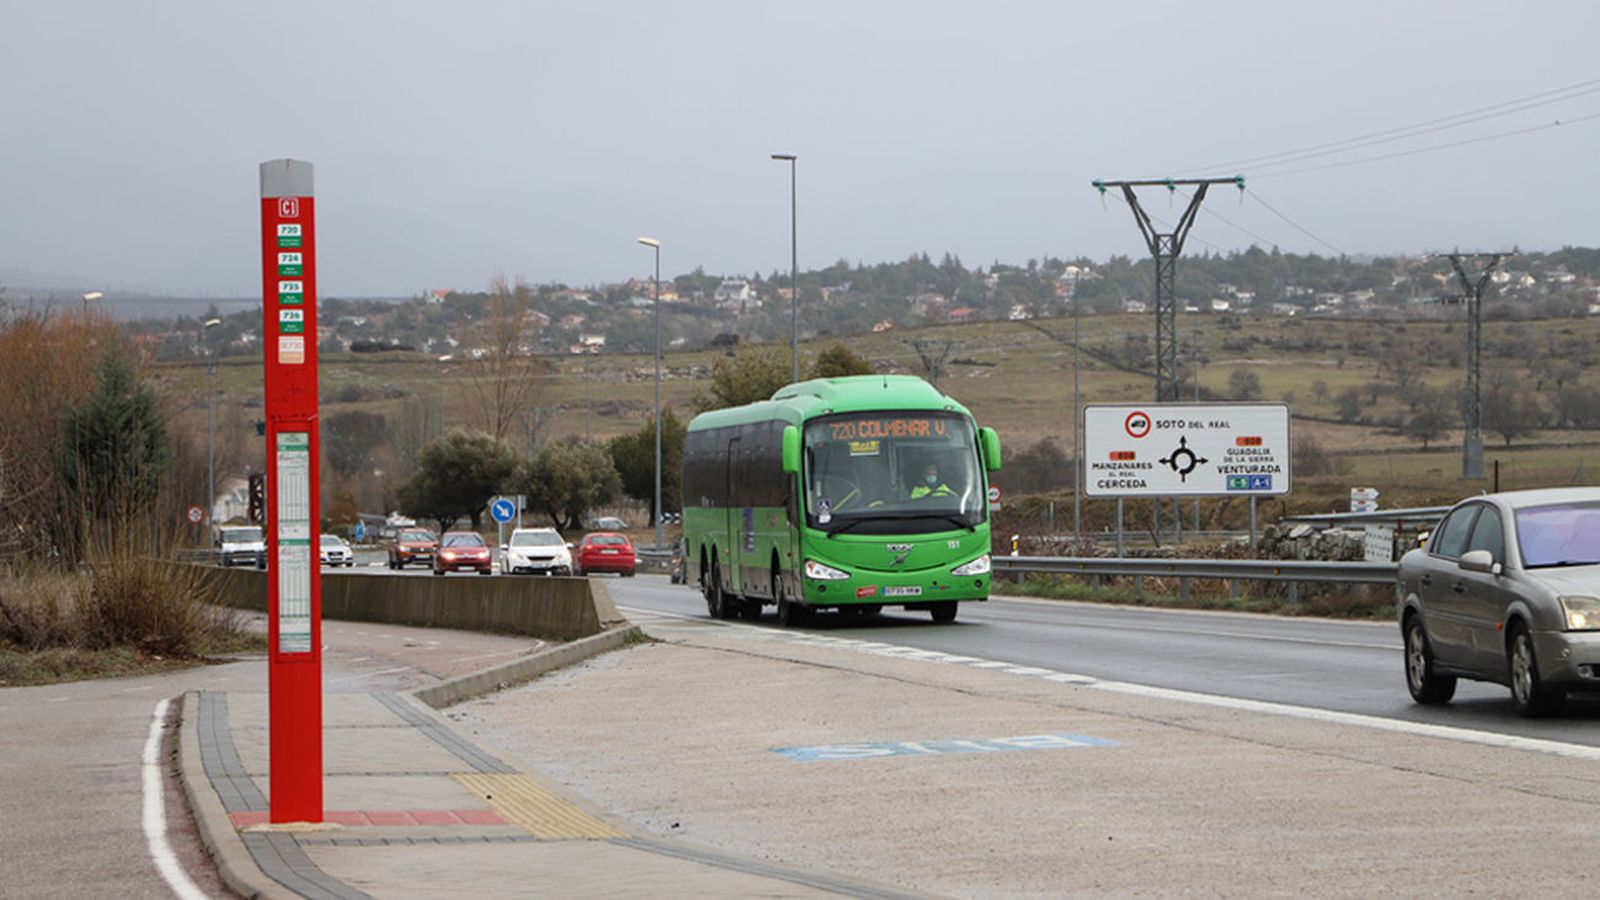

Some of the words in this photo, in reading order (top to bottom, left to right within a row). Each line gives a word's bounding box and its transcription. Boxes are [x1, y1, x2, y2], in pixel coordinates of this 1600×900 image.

[1156, 420, 1186, 429] SOTO
[1188, 421, 1204, 429] DEL
[1208, 421, 1230, 429] REAL
[829, 422, 857, 440] 720
[858, 419, 930, 438] COLMENAR
[1226, 448, 1270, 456] GUADALIX
[1092, 462, 1152, 470] MANZANARES
[1217, 464, 1281, 474] VENTURADA
[1097, 479, 1147, 489] CERCEDA
